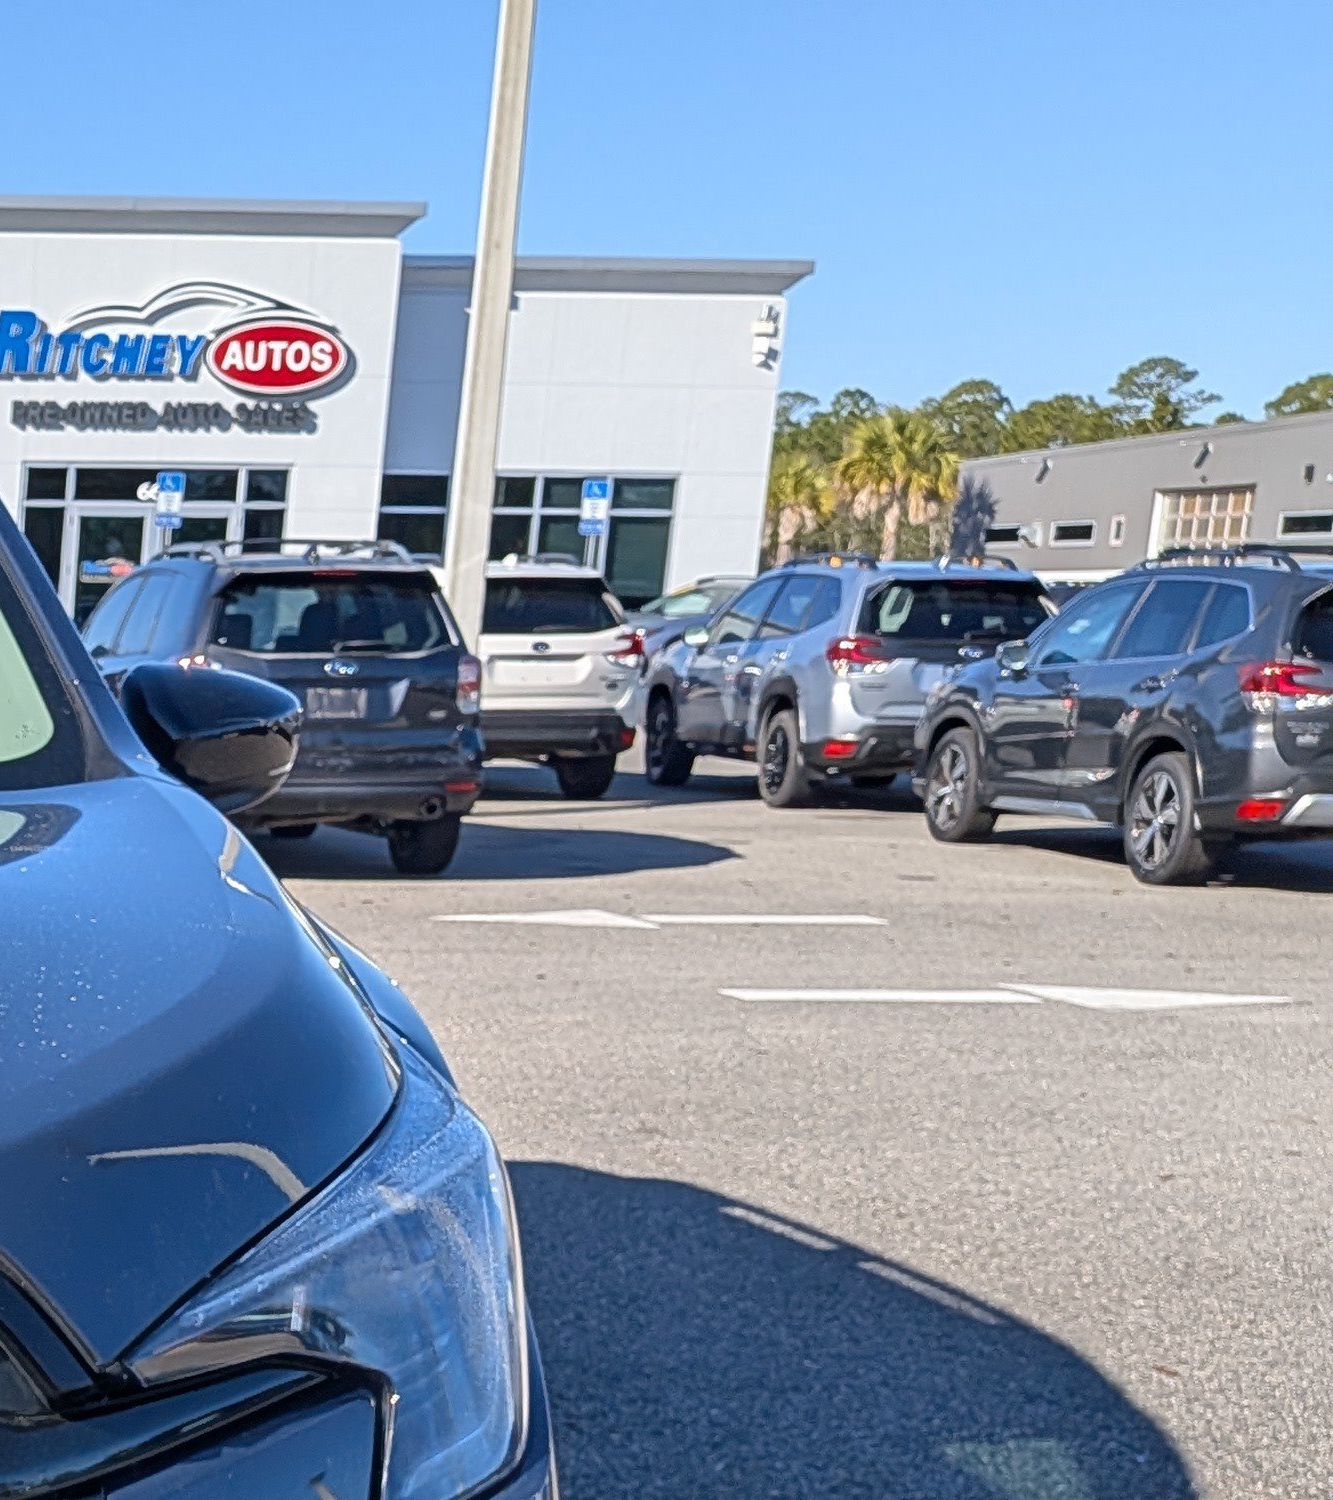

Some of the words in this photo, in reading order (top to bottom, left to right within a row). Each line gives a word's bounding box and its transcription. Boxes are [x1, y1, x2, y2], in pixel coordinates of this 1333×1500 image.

[221, 339, 333, 373] AUTOS
[160, 401, 231, 432] AUTO
[235, 401, 317, 433] SALES
